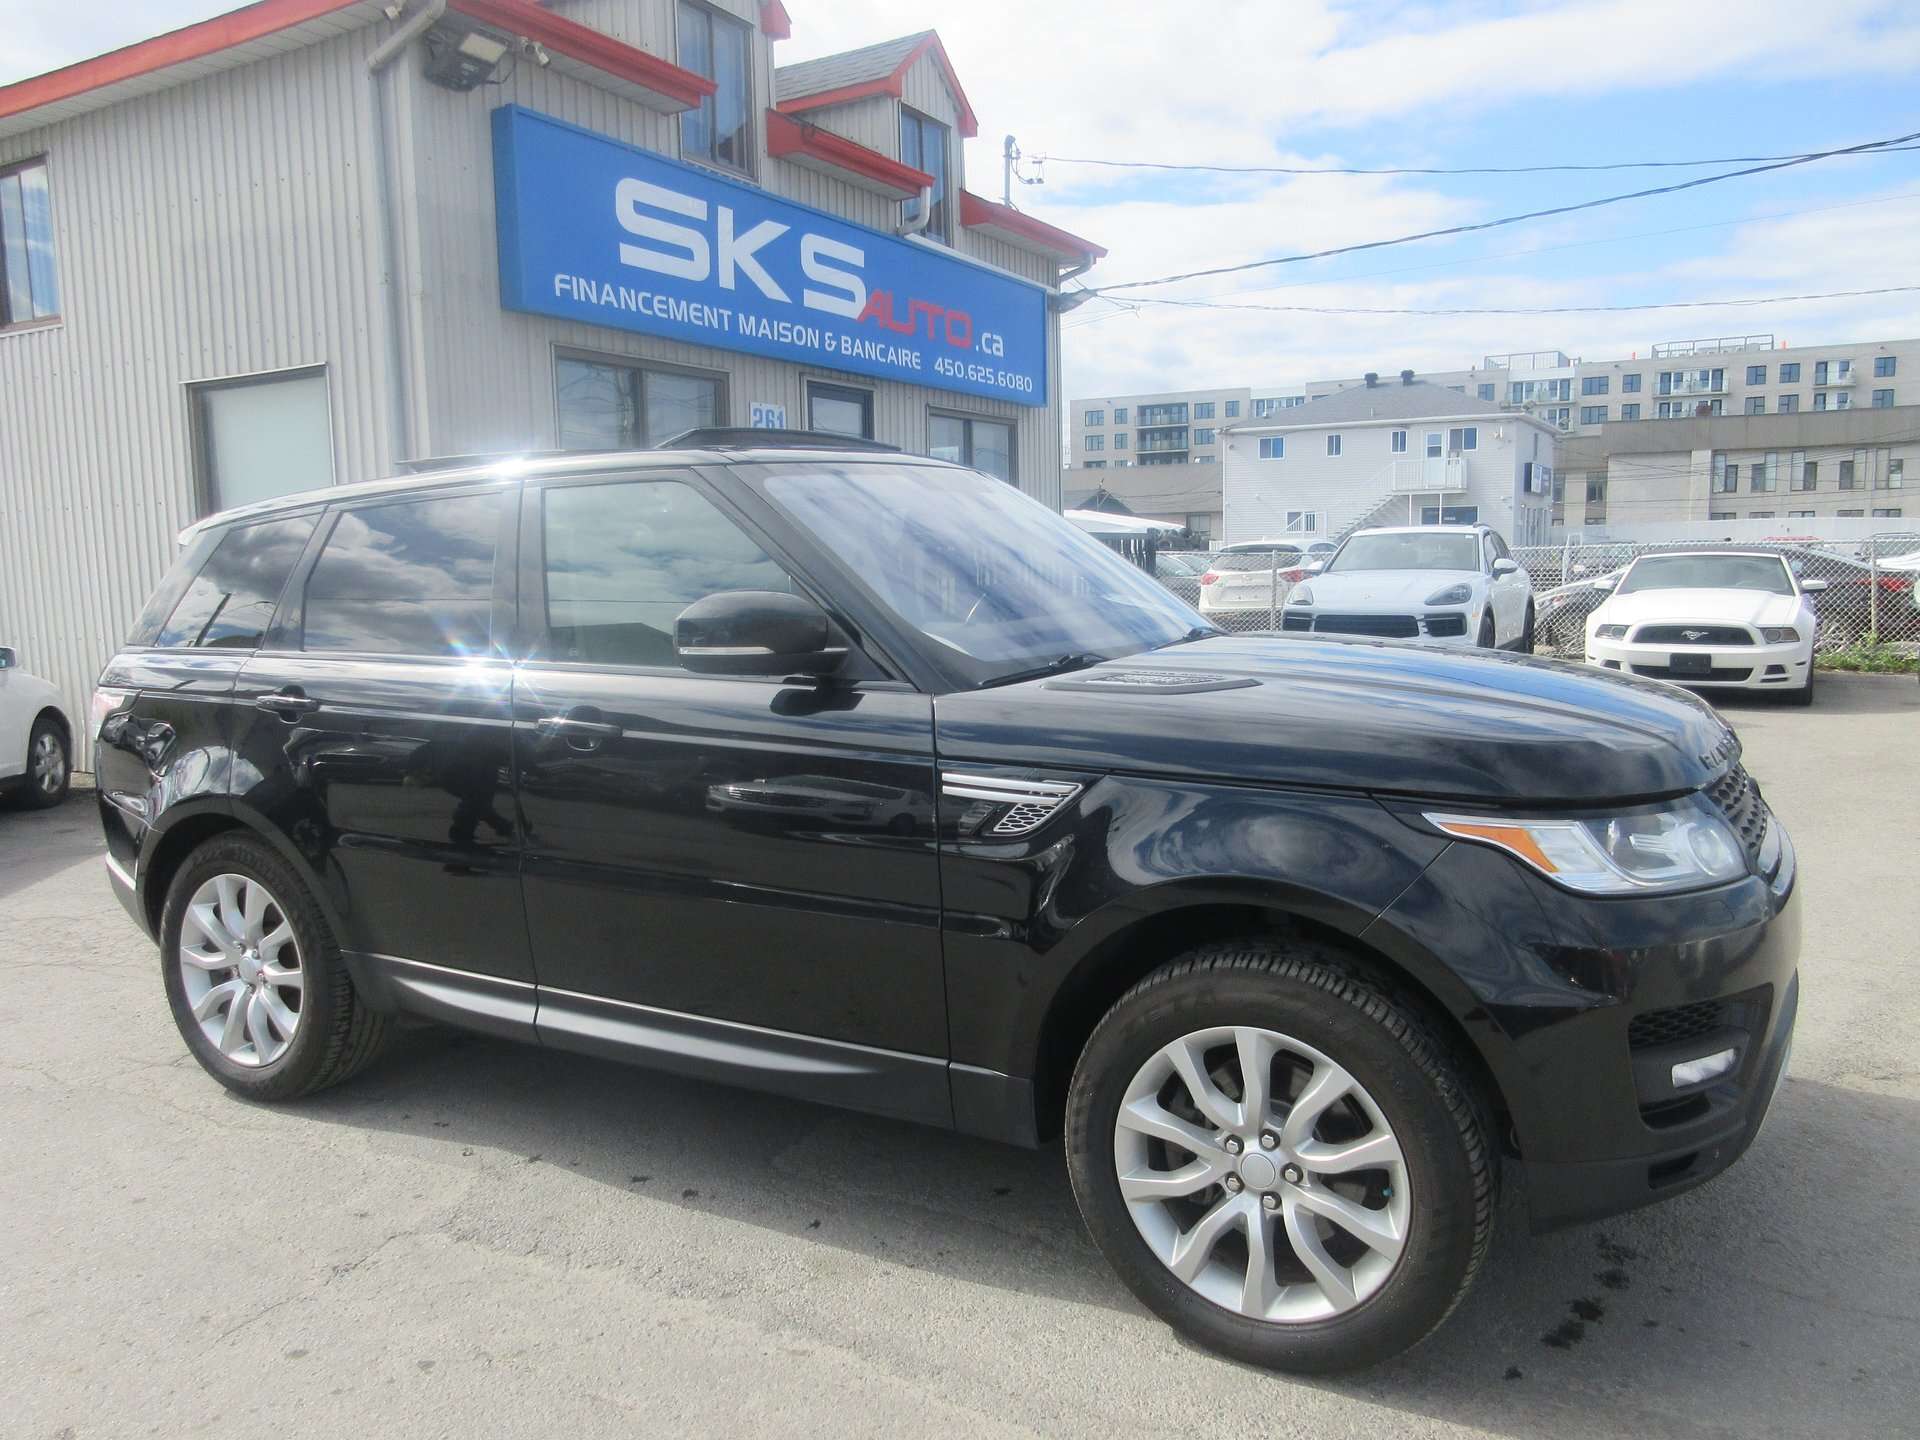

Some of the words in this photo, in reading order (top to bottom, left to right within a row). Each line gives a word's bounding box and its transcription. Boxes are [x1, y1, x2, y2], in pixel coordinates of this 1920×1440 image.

[615, 177, 868, 320] SKS
[554, 273, 732, 332] FINANCEMENT
[738, 313, 819, 349] MAISON
[824, 332, 837, 351] &
[841, 335, 921, 370] BANCAIRE
[934, 356, 1033, 393] 450.625.6080
